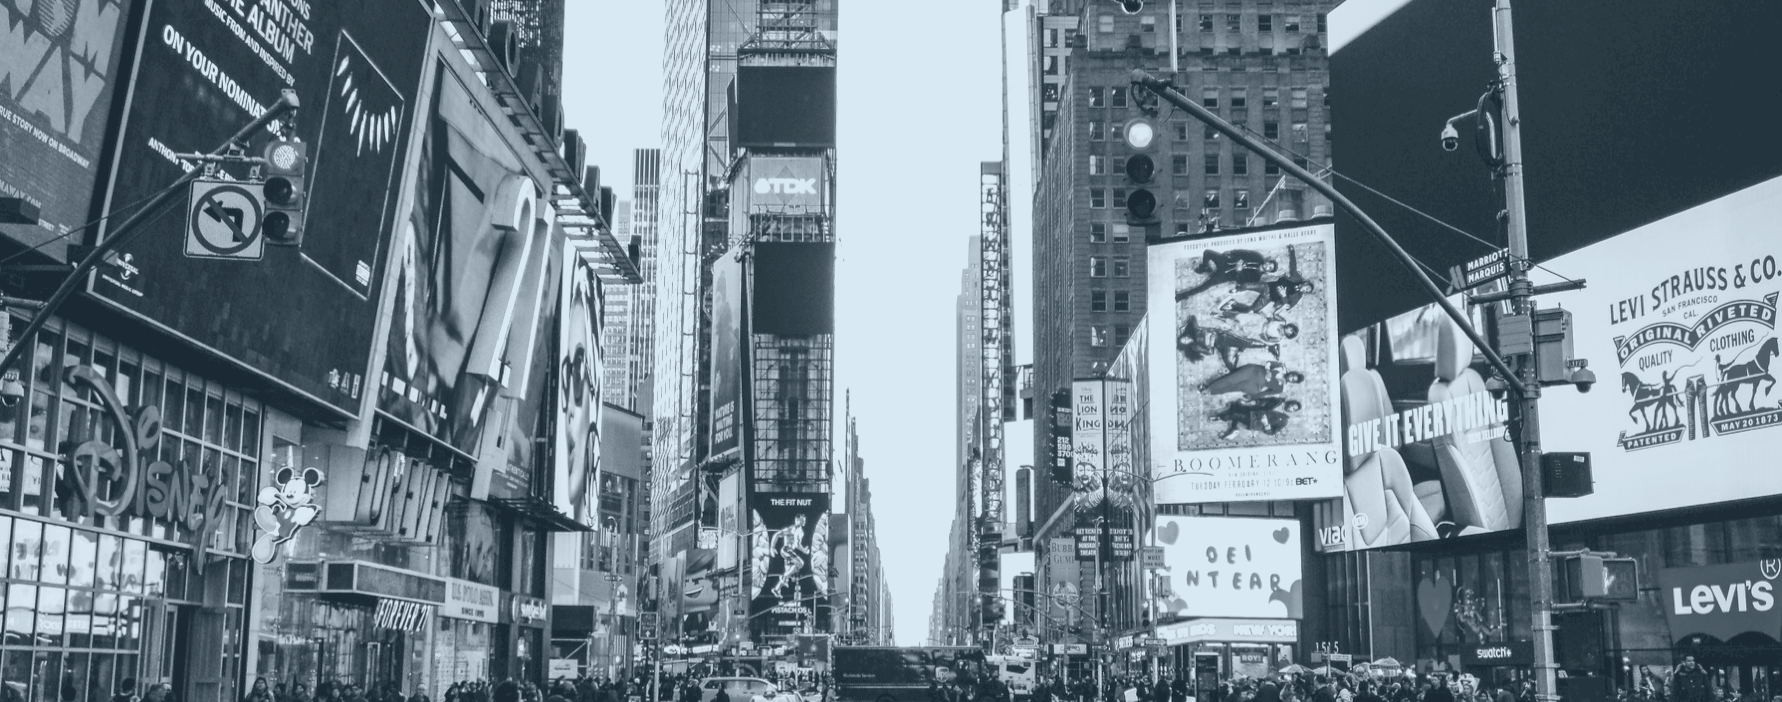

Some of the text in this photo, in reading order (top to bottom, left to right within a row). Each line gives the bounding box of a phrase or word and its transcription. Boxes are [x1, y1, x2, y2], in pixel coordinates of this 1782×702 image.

[204, 0, 227, 23] MUSIC
[226, 15, 246, 41] FROM
[245, 35, 260, 53] AND
[259, 47, 287, 79] INSPIRED
[286, 73, 295, 86] BY
[247, 4, 295, 64] ALBUM
[163, 25, 184, 54] ON
[186, 41, 219, 84] YOUR
[12, 114, 33, 134] STORY
[33, 127, 49, 144] NOW
[48, 137, 58, 150] ON
[58, 142, 90, 169] BROADWAY
[771, 178, 817, 194] TDK
[1467, 247, 1509, 271] MARRIOTT
[1468, 262, 1505, 283] MARQUIS
[1610, 255, 1782, 325] LEVI STRAUSS & CO.
[1662, 295, 1718, 317] SAN FRANCISCO
[1683, 309, 1699, 320] CAL.
[1620, 304, 1772, 359] ORIGINAL RIVETED
[1709, 328, 1755, 353] CLOTHING
[1639, 349, 1673, 372] QUALITY
[1080, 394, 1093, 402] THE
[1077, 404, 1098, 416] LION
[1076, 417, 1101, 431] KING
[1349, 390, 1508, 457] GIVE IT EVERYTHING
[1720, 413, 1779, 432] MAY 20 1873
[1057, 436, 1070, 444] 212
[1627, 432, 1677, 449] PATENTED
[1174, 450, 1337, 473] BOOMERANG
[1191, 481, 1221, 490] TUESDAY
[1224, 479, 1260, 488] FEBRUARY
[1263, 479, 1270, 487] 12
[1296, 477, 1314, 485] BET
[375, 599, 430, 632] FOREVER 21
[461, 607, 474, 616] SINCE
[1233, 624, 1265, 636] NEW
[1477, 647, 1506, 658] swatch
